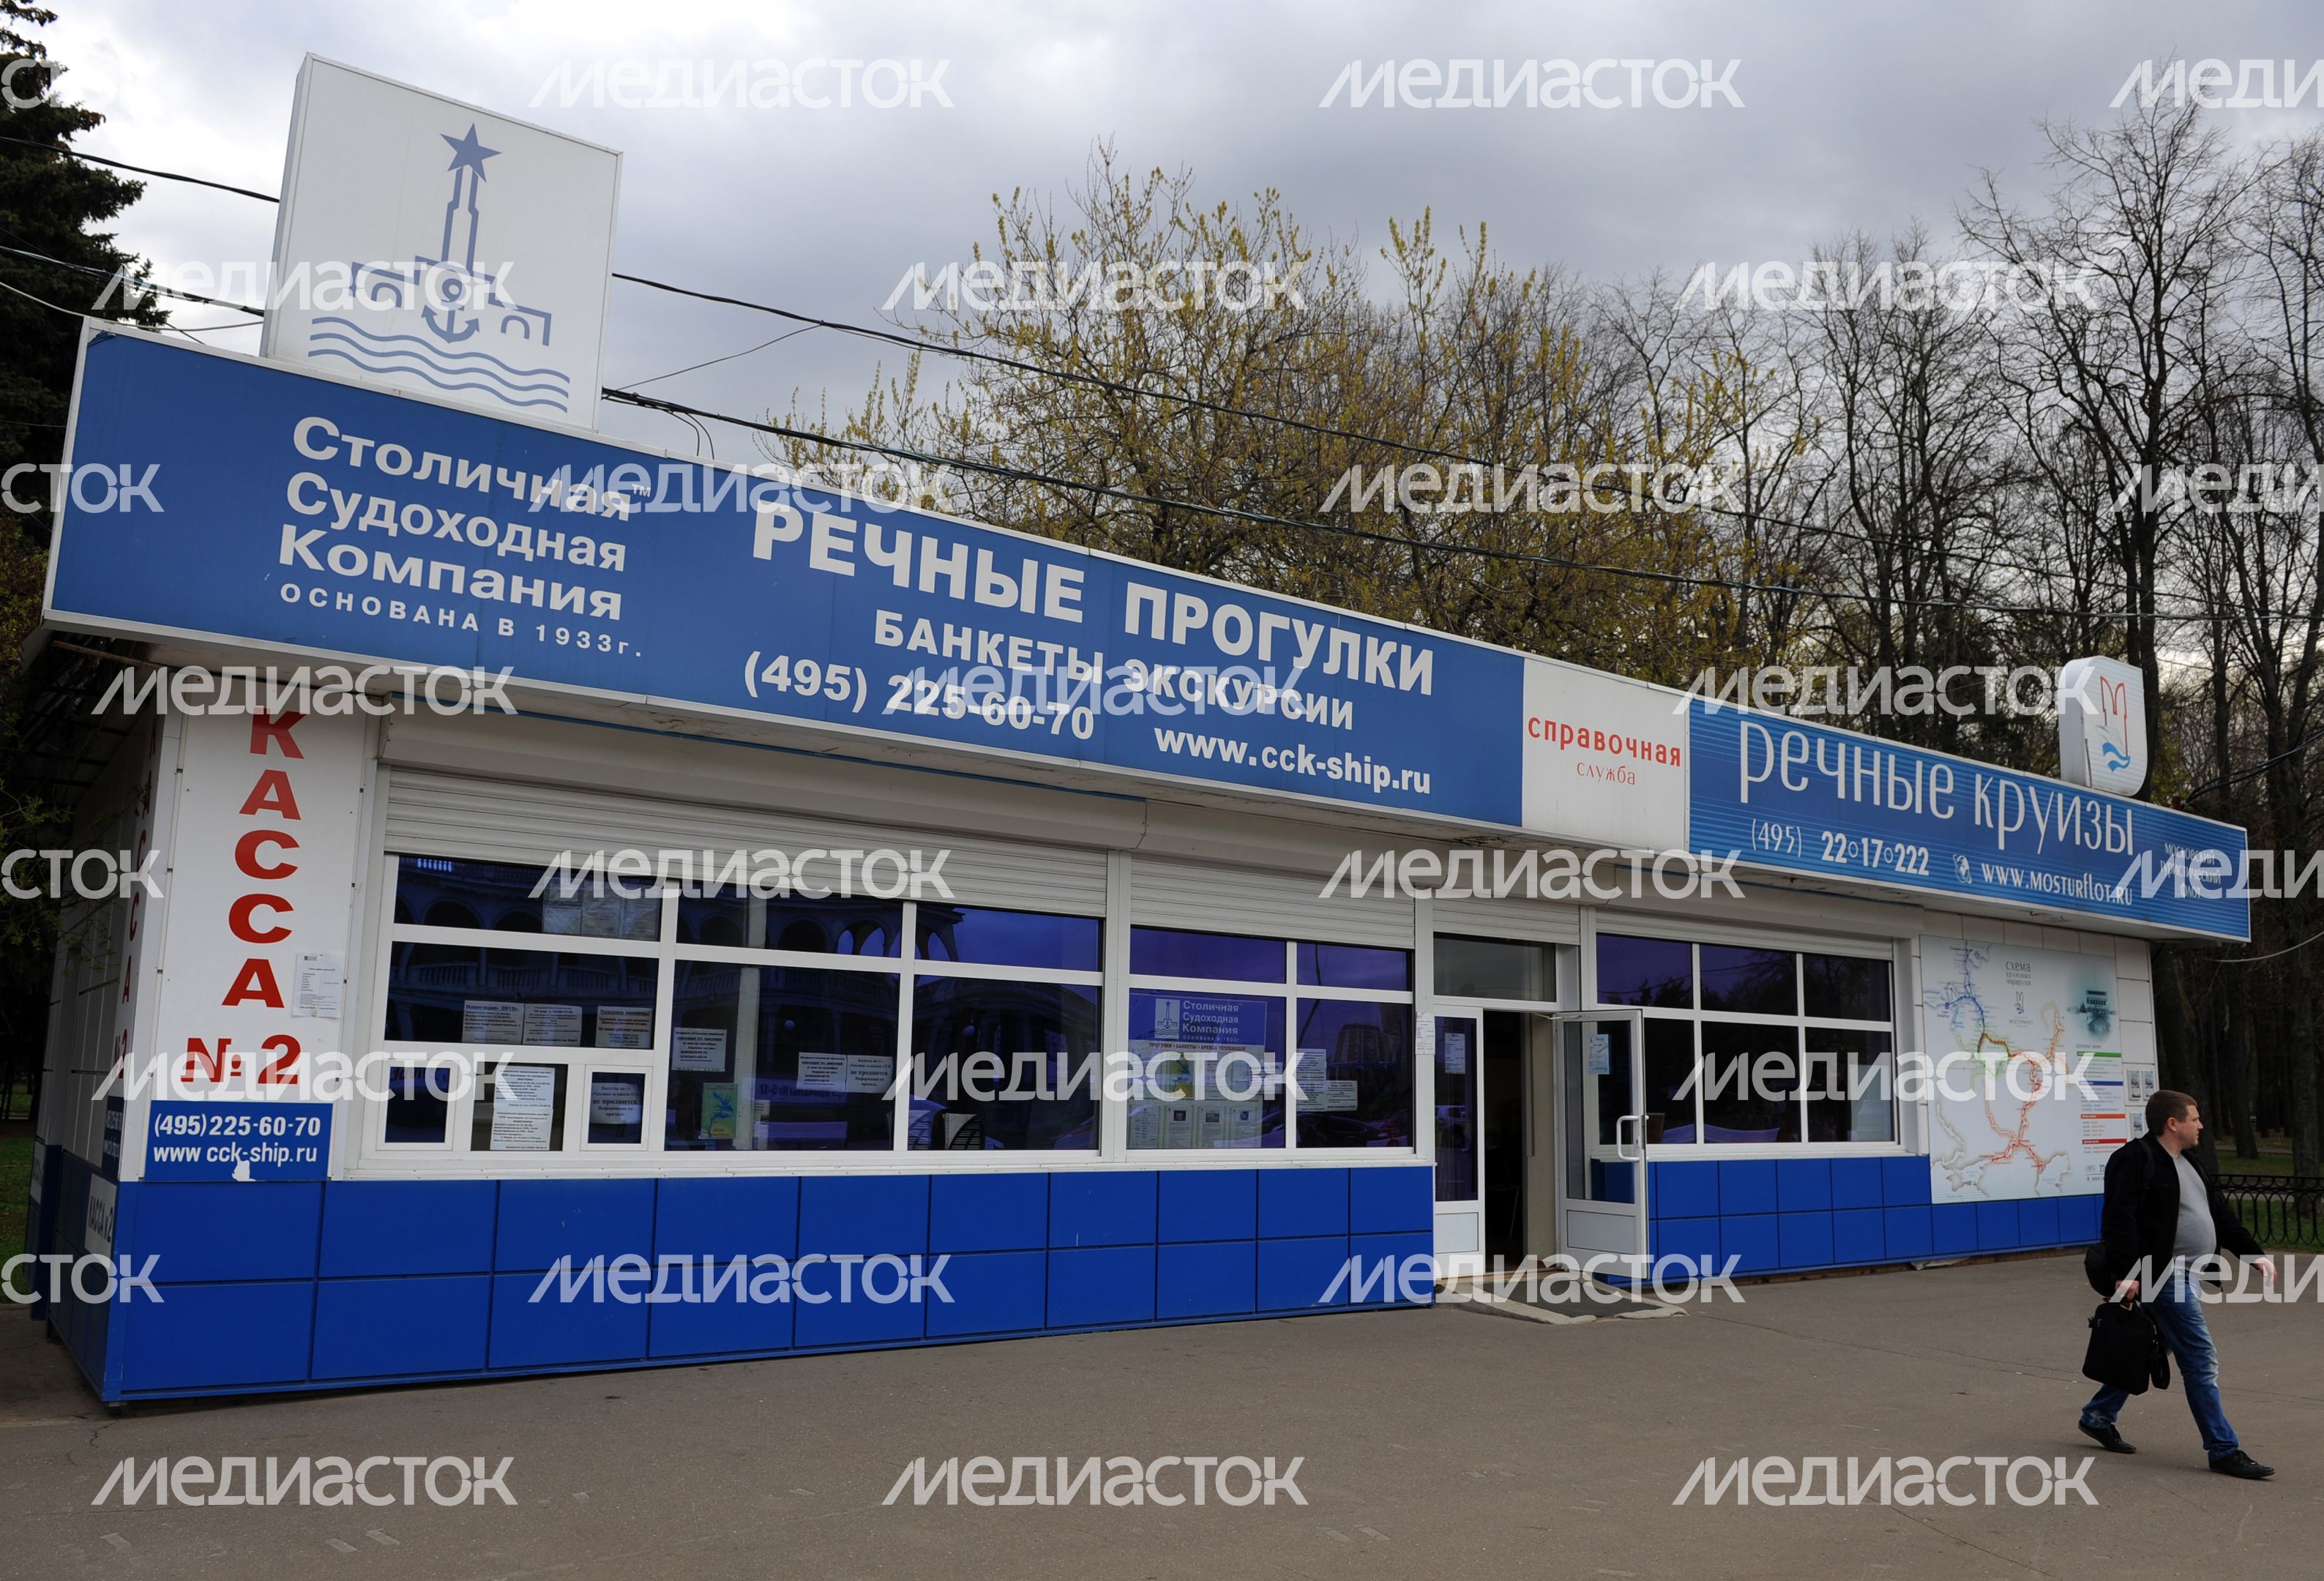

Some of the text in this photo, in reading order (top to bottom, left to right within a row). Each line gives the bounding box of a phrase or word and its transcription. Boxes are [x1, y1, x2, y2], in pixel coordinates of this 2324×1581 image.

[292, 416, 631, 521] Столичная
[286, 472, 627, 572] Судоходная
[278, 523, 622, 621] Компания
[752, 498, 1434, 695] РЕЧНЫЕ ПРОГУЛКИ
[280, 583, 479, 632] ОСНОВАНА
[535, 624, 642, 657] 1933г.
[744, 651, 1094, 740] (495) 225-60-70
[875, 608, 1353, 730] БАНКЕТЫ ЭКСКУРСИИ
[1154, 727, 1431, 794] www.cck-ship.ru
[1528, 717, 1681, 767] справочная
[1577, 762, 1636, 785] служба
[222, 706, 307, 1009] КАССА
[1752, 818, 1801, 858] (495)
[1182, 1023, 1238, 1034] Компания
[1183, 1000, 1238, 1012] Столичная
[1183, 1012, 1238, 1024] Судоходная
